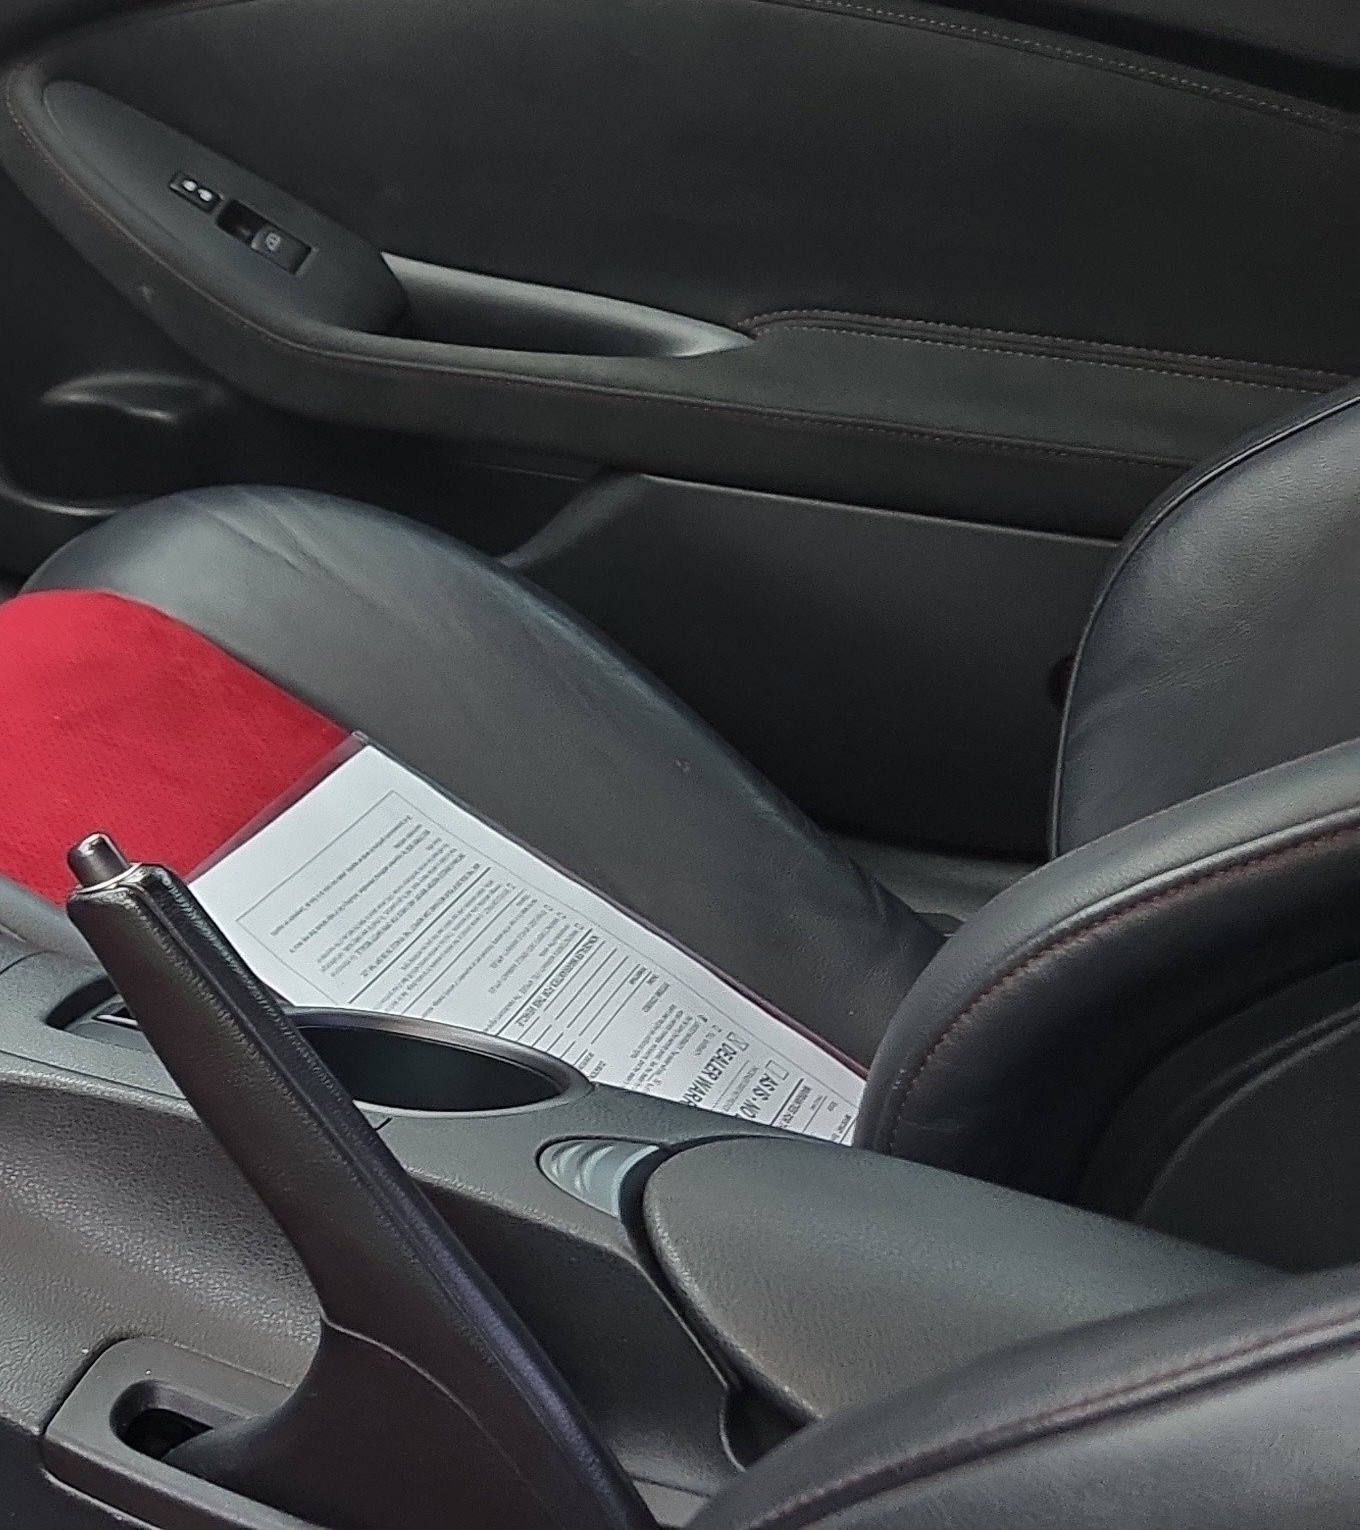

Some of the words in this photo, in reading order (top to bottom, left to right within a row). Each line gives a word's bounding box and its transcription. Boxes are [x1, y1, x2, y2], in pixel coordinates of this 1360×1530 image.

[698, 1041, 740, 1082] DEALER
[756, 1072, 780, 1092] AS
[737, 1099, 762, 1120] NO
